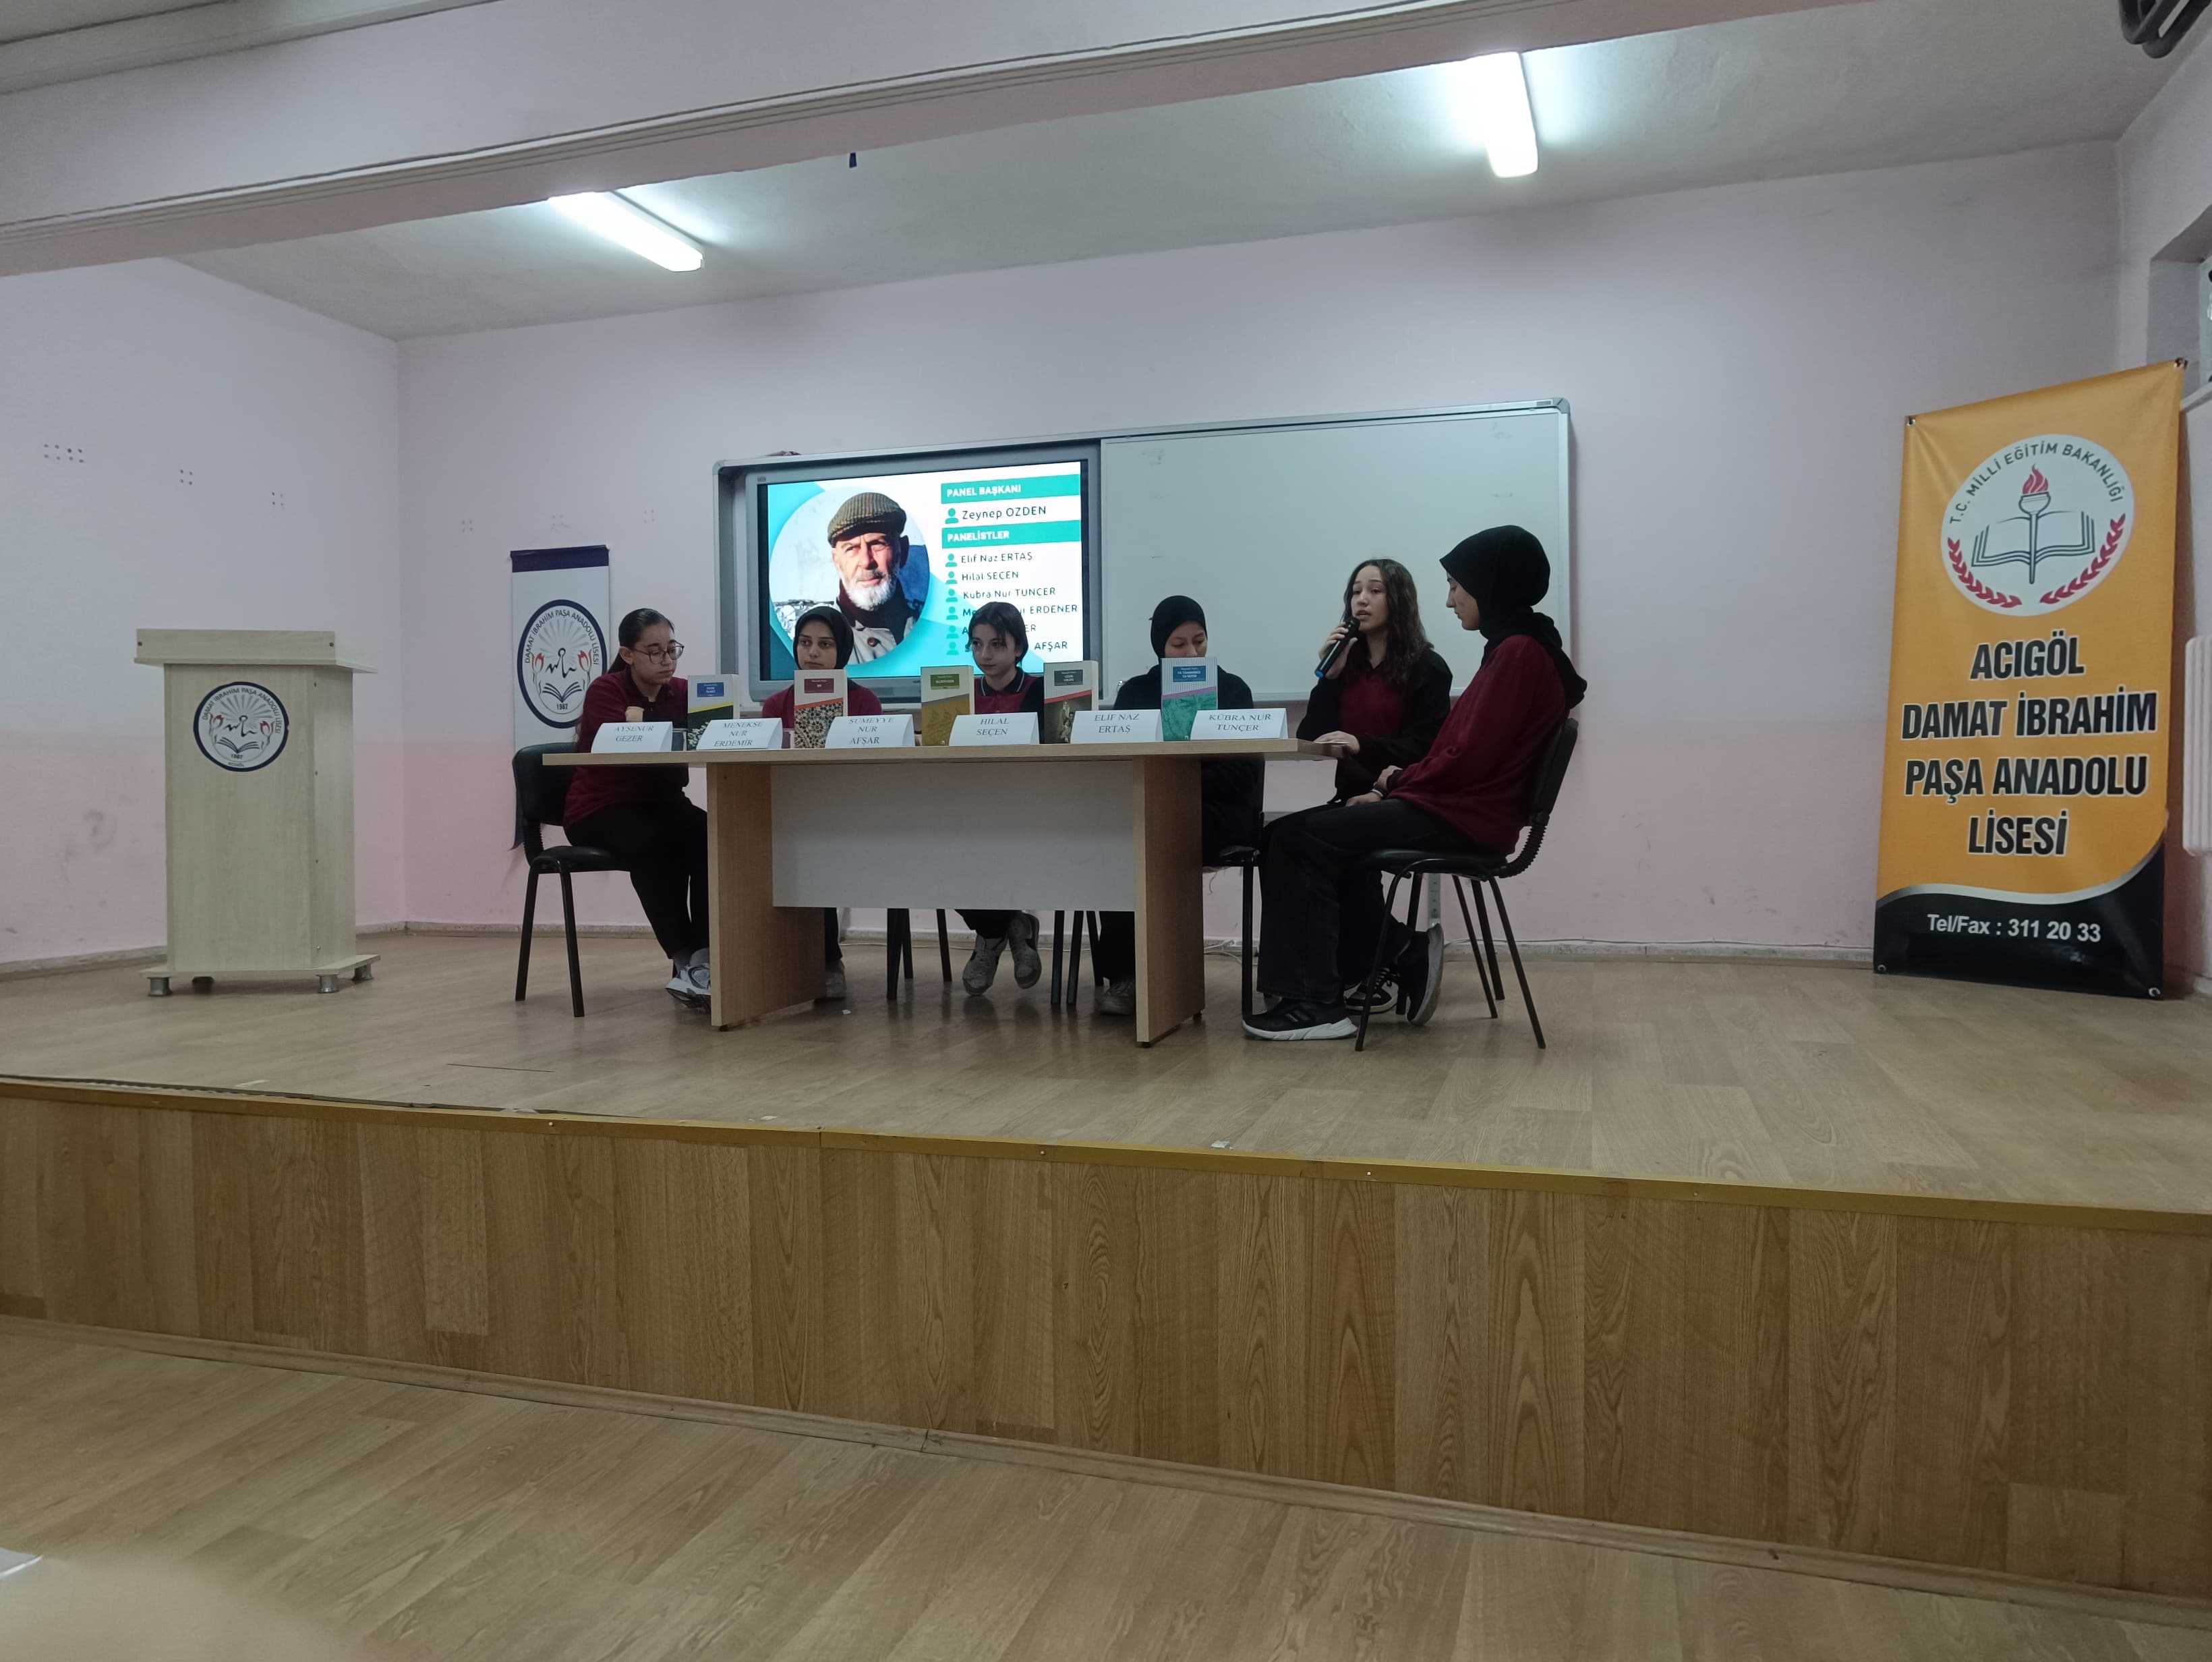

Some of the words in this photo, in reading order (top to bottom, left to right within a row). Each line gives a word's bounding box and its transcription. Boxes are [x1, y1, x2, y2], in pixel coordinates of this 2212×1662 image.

[1966, 459, 2001, 496] MİLLİ
[2004, 440, 2058, 465] EĞİTİM
[2062, 444, 2124, 502] BAKANLIĞI
[947, 488, 977, 497] PANEL
[962, 511, 1002, 521] Zeynep
[948, 530, 1010, 542] PANELİSTLER
[980, 554, 997, 563] Naz
[962, 572, 983, 581] Hilal
[525, 635, 534, 663] DAMAT
[531, 611, 554, 635] İBRAHİM
[555, 609, 571, 619] PAŞA
[571, 612, 596, 641] ANADOLU
[1034, 641, 1068, 652] AFŞAR
[1970, 630, 2085, 680] ACIGÖL
[1901, 699, 2007, 739] DAMAT
[2016, 685, 2157, 736] İBRAHİM
[977, 728, 1008, 737] SEÇEN
[1099, 725, 1131, 734] ERTAŞ
[1904, 757, 1984, 804] PAŞA
[1992, 755, 2149, 797] ANADOLU
[1968, 809, 2068, 856] LİSESİ
[1927, 914, 1990, 934] Tel/Fax
[2008, 919, 2039, 938] 311
[2046, 921, 2071, 940] 20
[2077, 923, 2101, 942] 33
